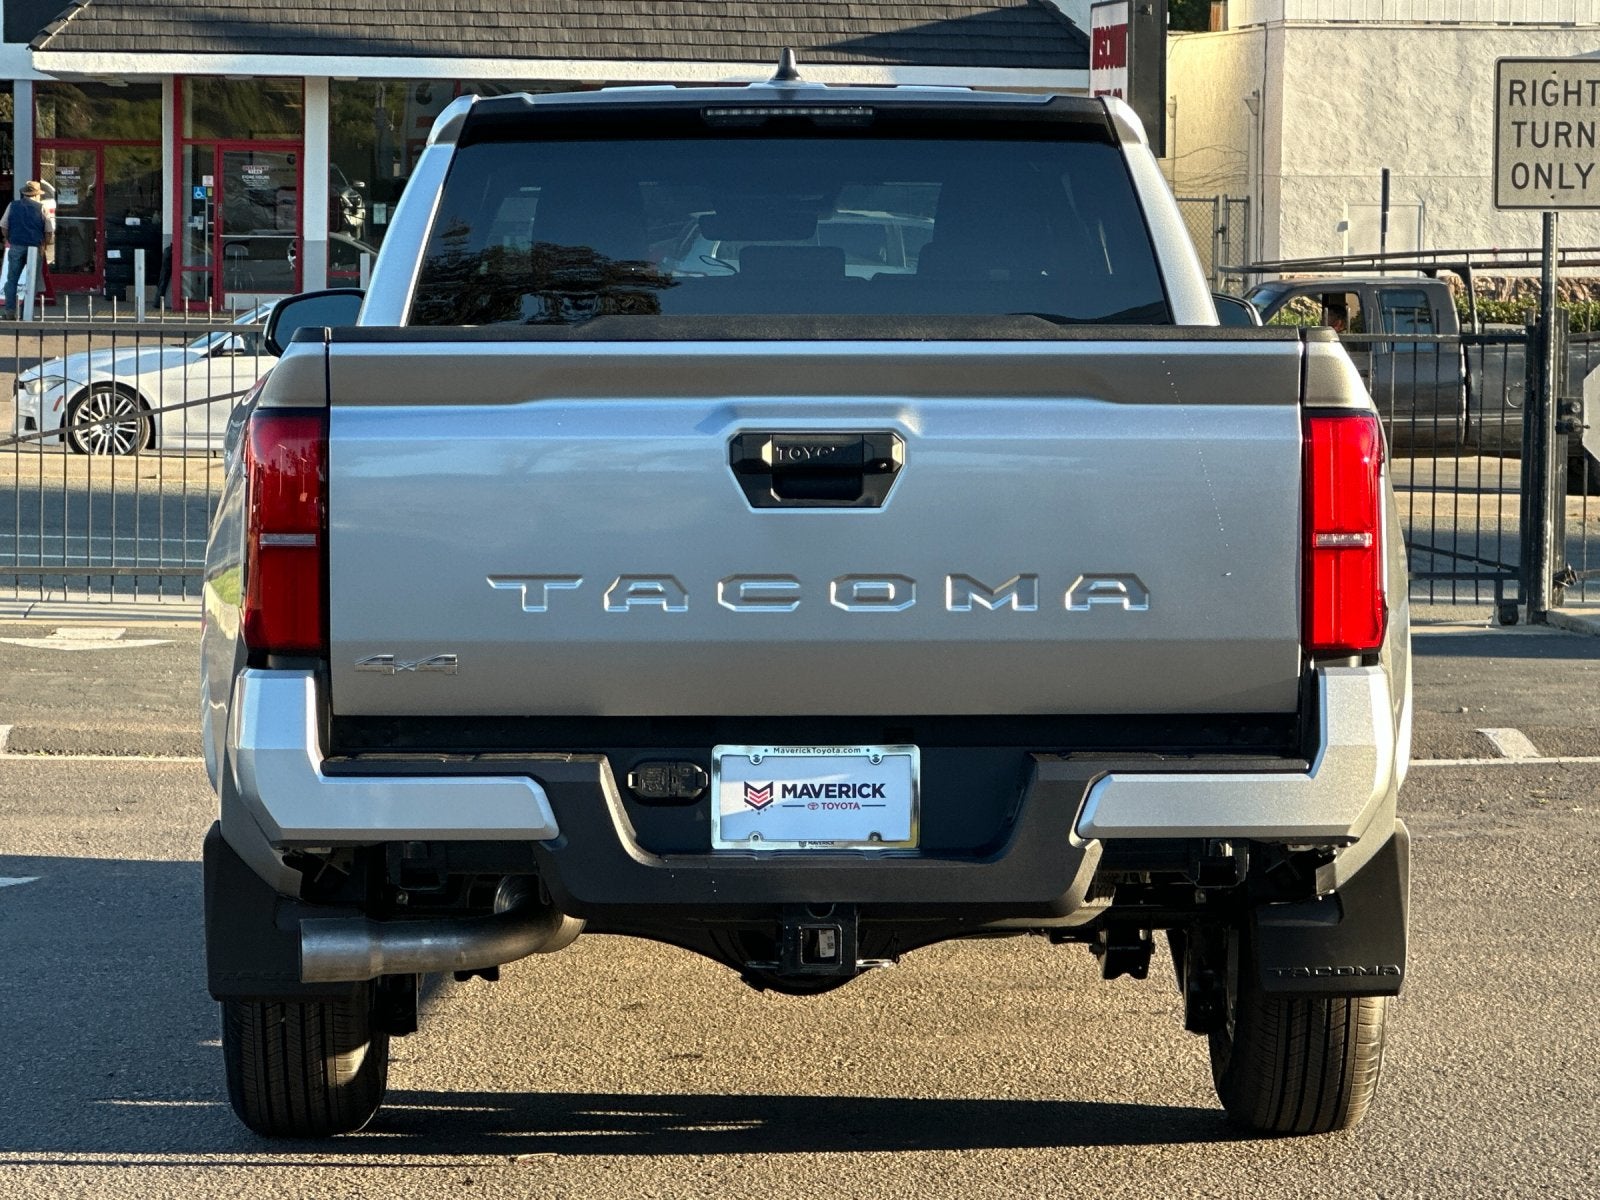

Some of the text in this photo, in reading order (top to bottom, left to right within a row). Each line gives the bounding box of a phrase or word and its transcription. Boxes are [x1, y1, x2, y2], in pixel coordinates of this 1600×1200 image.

[1509, 79, 1600, 107] RIGHT
[1511, 121, 1596, 149] TURN
[1511, 162, 1595, 190] ONLY
[486, 573, 1151, 613] TACOMA
[773, 747, 861, 755] MaverickToyota.com
[781, 783, 886, 799] MAVERICK
[821, 802, 861, 811] TOYOTA
[1267, 964, 1401, 977] TACOMA
